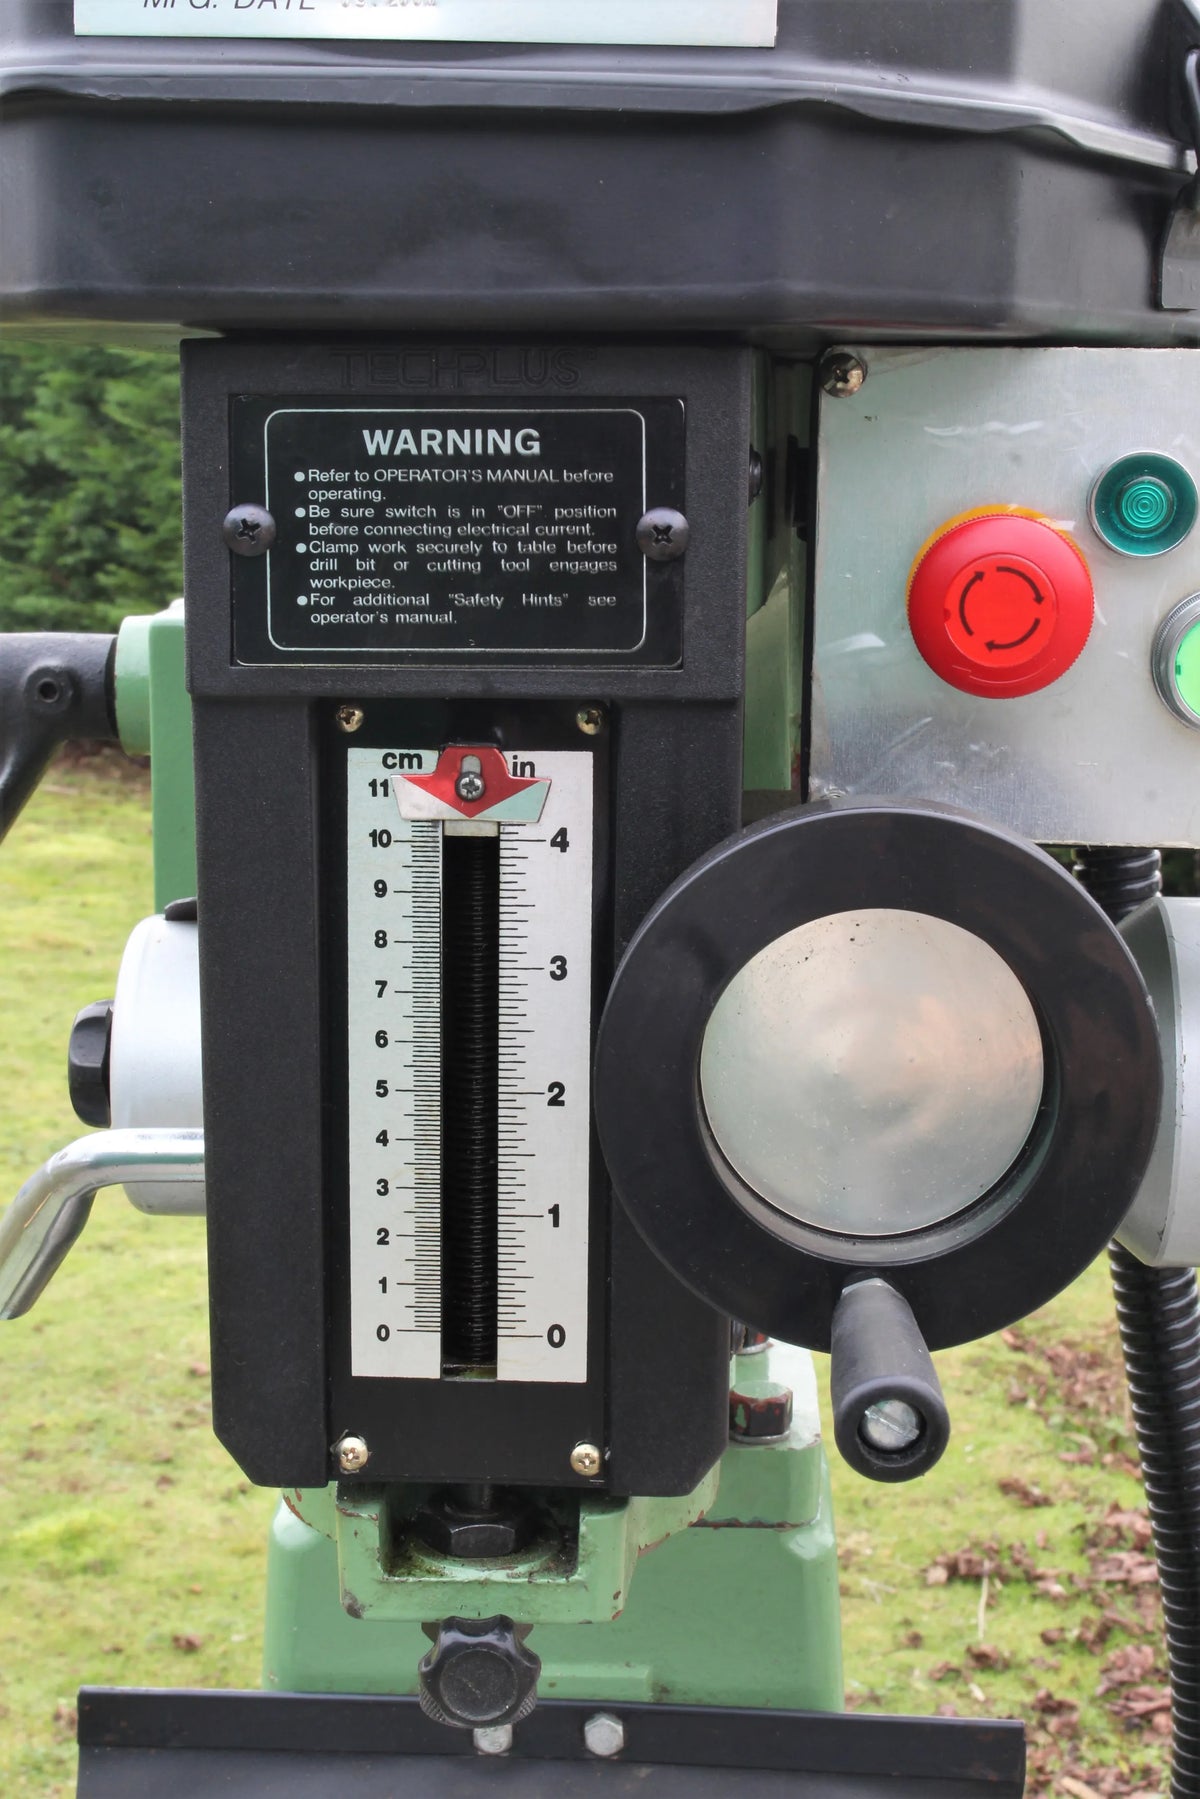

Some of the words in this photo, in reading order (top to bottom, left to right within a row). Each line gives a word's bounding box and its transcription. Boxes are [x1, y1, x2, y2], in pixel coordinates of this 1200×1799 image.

[331, 350, 582, 388] TECHPLUS
[362, 428, 541, 456] WARNING
[308, 469, 350, 482] Refer
[354, 470, 369, 482] to
[374, 468, 482, 482] OPERATOR'S
[487, 469, 559, 482] MANUAL
[563, 469, 614, 482] before
[308, 488, 386, 502] operating.
[309, 505, 330, 518] Be
[341, 508, 374, 518] sure
[385, 505, 436, 518] switch
[448, 505, 460, 518] is
[472, 506, 485, 518] in
[555, 505, 617, 520] position
[309, 523, 358, 535] before
[364, 523, 451, 538] connecting
[457, 523, 529, 536] electrical
[535, 523, 595, 536] current.
[309, 541, 358, 555] Clamp
[369, 541, 407, 553] work
[416, 541, 482, 556] securely
[493, 540, 507, 553] to
[518, 541, 556, 553] table
[567, 540, 617, 554] before
[310, 559, 338, 571] drill
[356, 559, 376, 571] bit
[394, 561, 409, 571] or
[427, 559, 481, 574] cutting
[501, 559, 530, 571] tool
[550, 561, 617, 574] engages
[310, 576, 395, 590] workpiece.
[310, 594, 335, 606] For
[353, 593, 430, 606] additional
[448, 593, 504, 609] "Safety
[522, 593, 568, 606] Hints"
[588, 595, 617, 606] see
[311, 611, 388, 625] operator's
[396, 611, 457, 624] manual.
[382, 752, 423, 770] cm
[512, 755, 535, 778] in
[369, 779, 389, 797] 11
[369, 830, 392, 848] 10
[550, 827, 570, 853] 4
[374, 880, 388, 898] 9
[374, 930, 388, 948] 8
[550, 955, 568, 981] 3
[375, 980, 388, 998] 7
[375, 1030, 388, 1048] 6
[375, 1080, 389, 1098] 5
[547, 1082, 566, 1107] 2
[376, 1130, 389, 1147] 4
[376, 1179, 389, 1196] 3
[548, 1204, 560, 1228] 1
[376, 1228, 389, 1245] 2
[378, 1277, 387, 1293] 1
[376, 1325, 390, 1341] 0
[547, 1324, 566, 1348] 0
